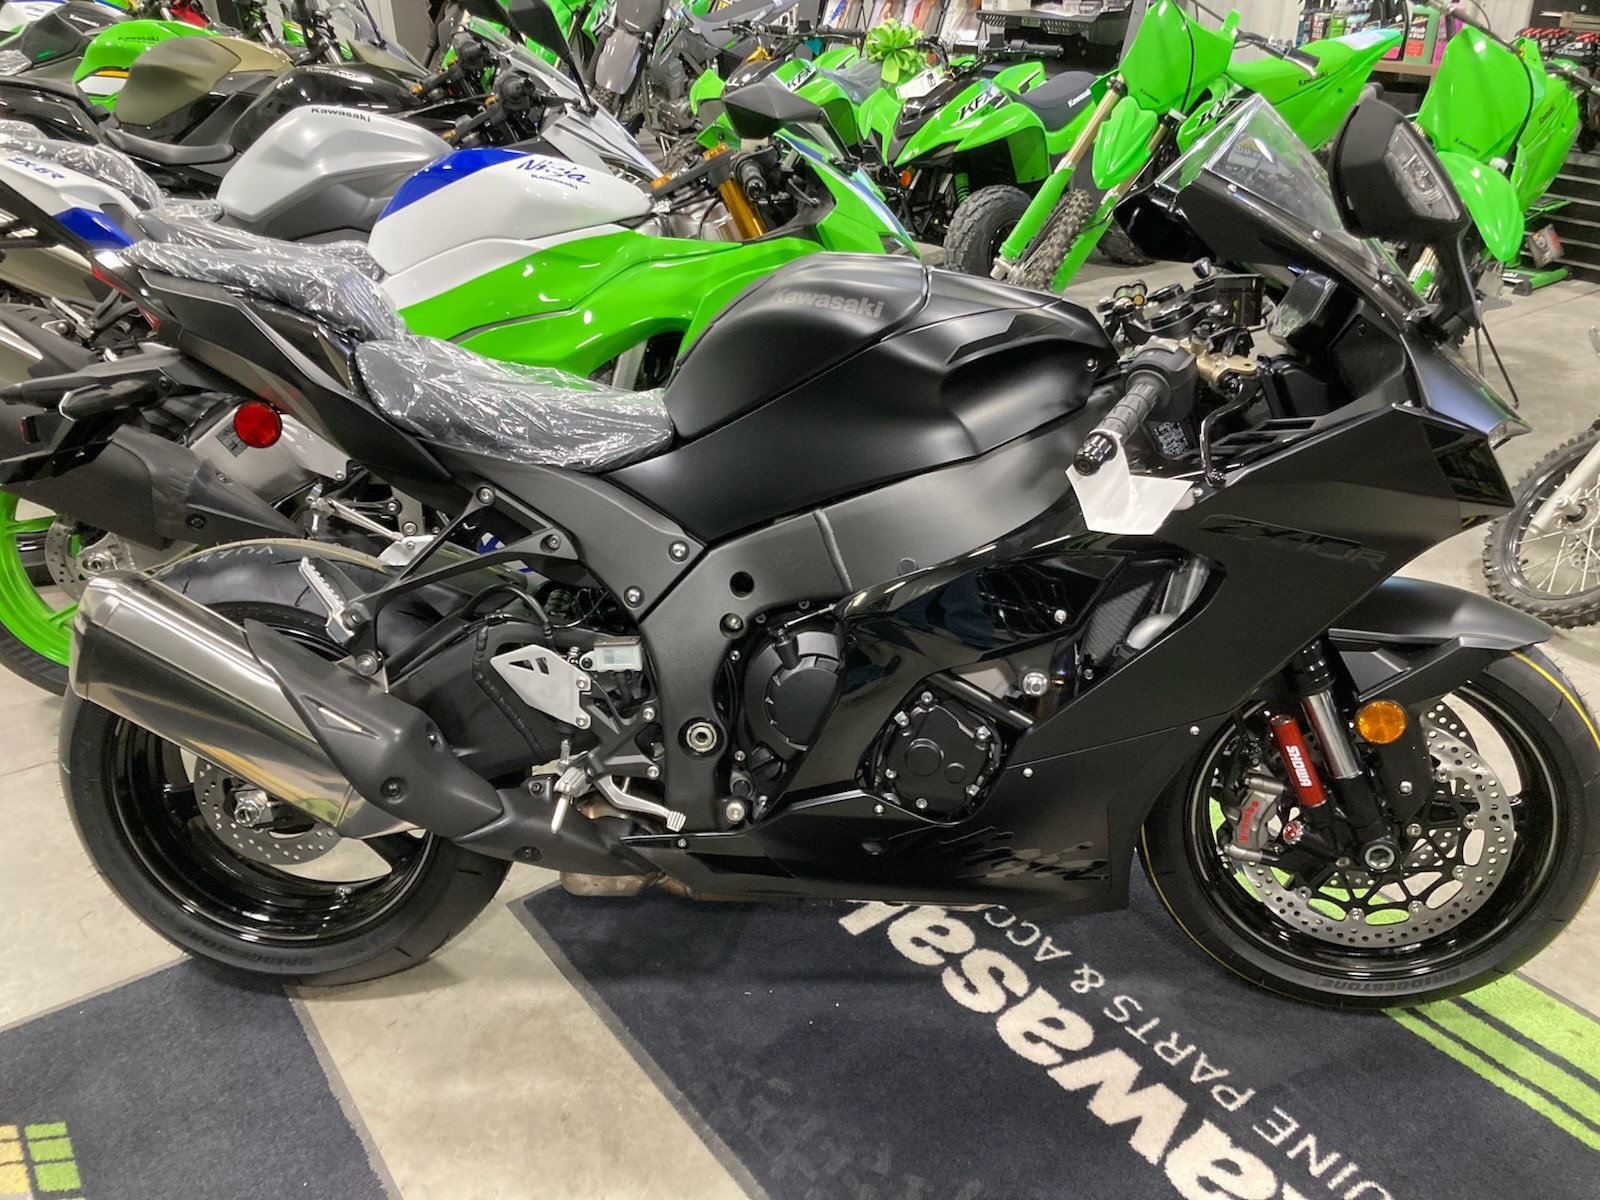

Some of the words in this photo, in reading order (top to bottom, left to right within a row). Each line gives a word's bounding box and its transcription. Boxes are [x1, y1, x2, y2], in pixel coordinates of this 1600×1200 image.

[311, 107, 371, 122] Kawasaki
[516, 159, 590, 184] Ninja
[772, 287, 884, 319] Kawasaki
[1286, 745, 1323, 788] SHOWA
[1069, 962, 1106, 994] &
[1103, 994, 1257, 1112] PARTS
